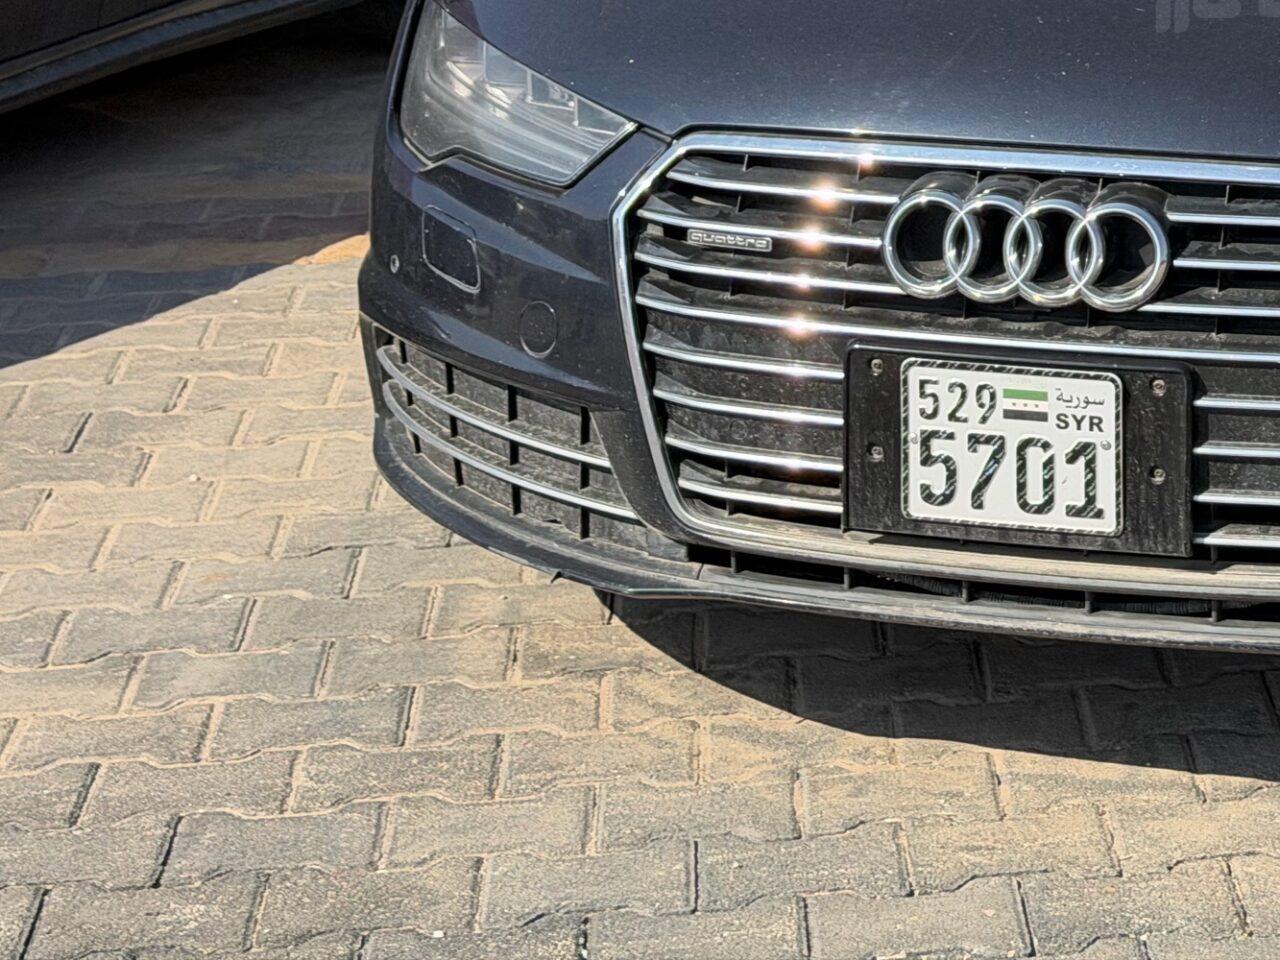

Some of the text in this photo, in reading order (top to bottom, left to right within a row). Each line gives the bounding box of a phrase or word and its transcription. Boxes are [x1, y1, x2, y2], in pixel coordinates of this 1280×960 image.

[691, 231, 768, 249] quattro
[918, 378, 998, 425] 529
[1055, 387, 1105, 410] سورية
[1055, 412, 1104, 433] SYR
[919, 429, 1105, 520] 5701
